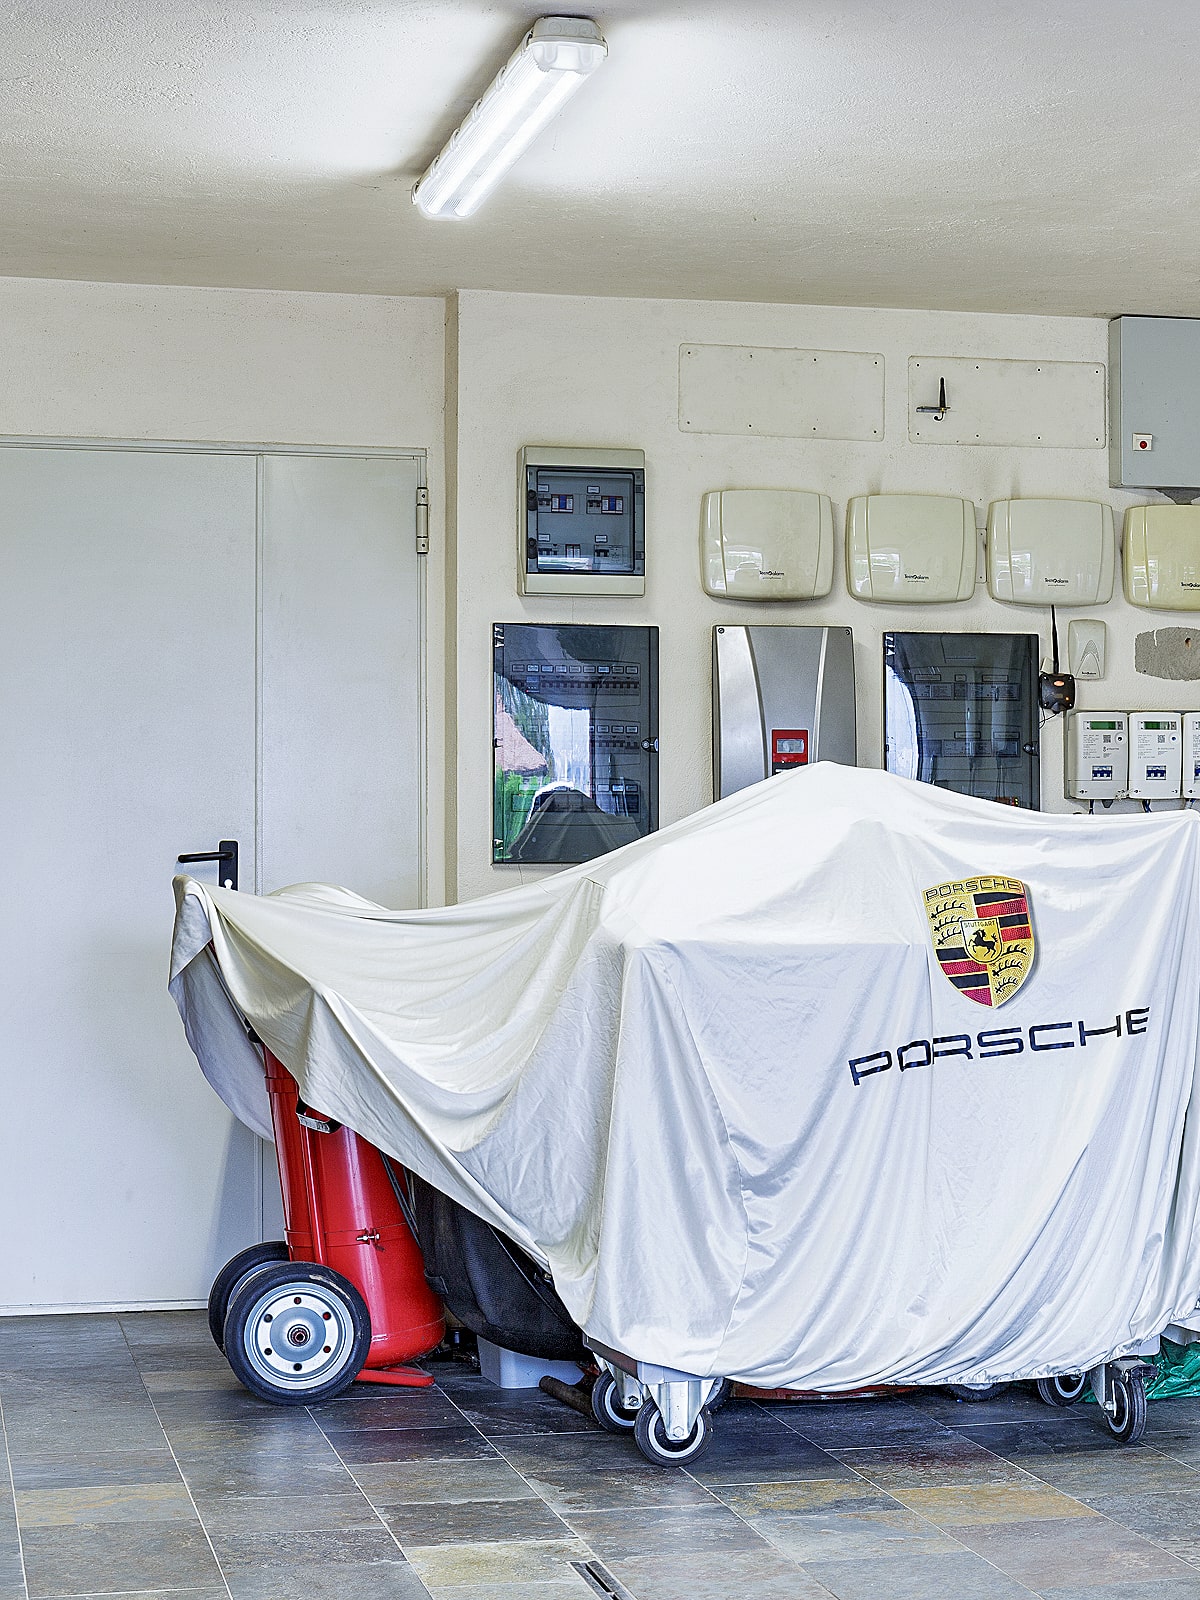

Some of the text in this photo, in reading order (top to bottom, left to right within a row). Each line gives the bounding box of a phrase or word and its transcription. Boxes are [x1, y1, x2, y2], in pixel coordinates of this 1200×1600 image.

[925, 878, 1021, 902] PORSCHE
[963, 920, 996, 928] STUTTGART
[848, 1006, 1151, 1087] PORSCHE
